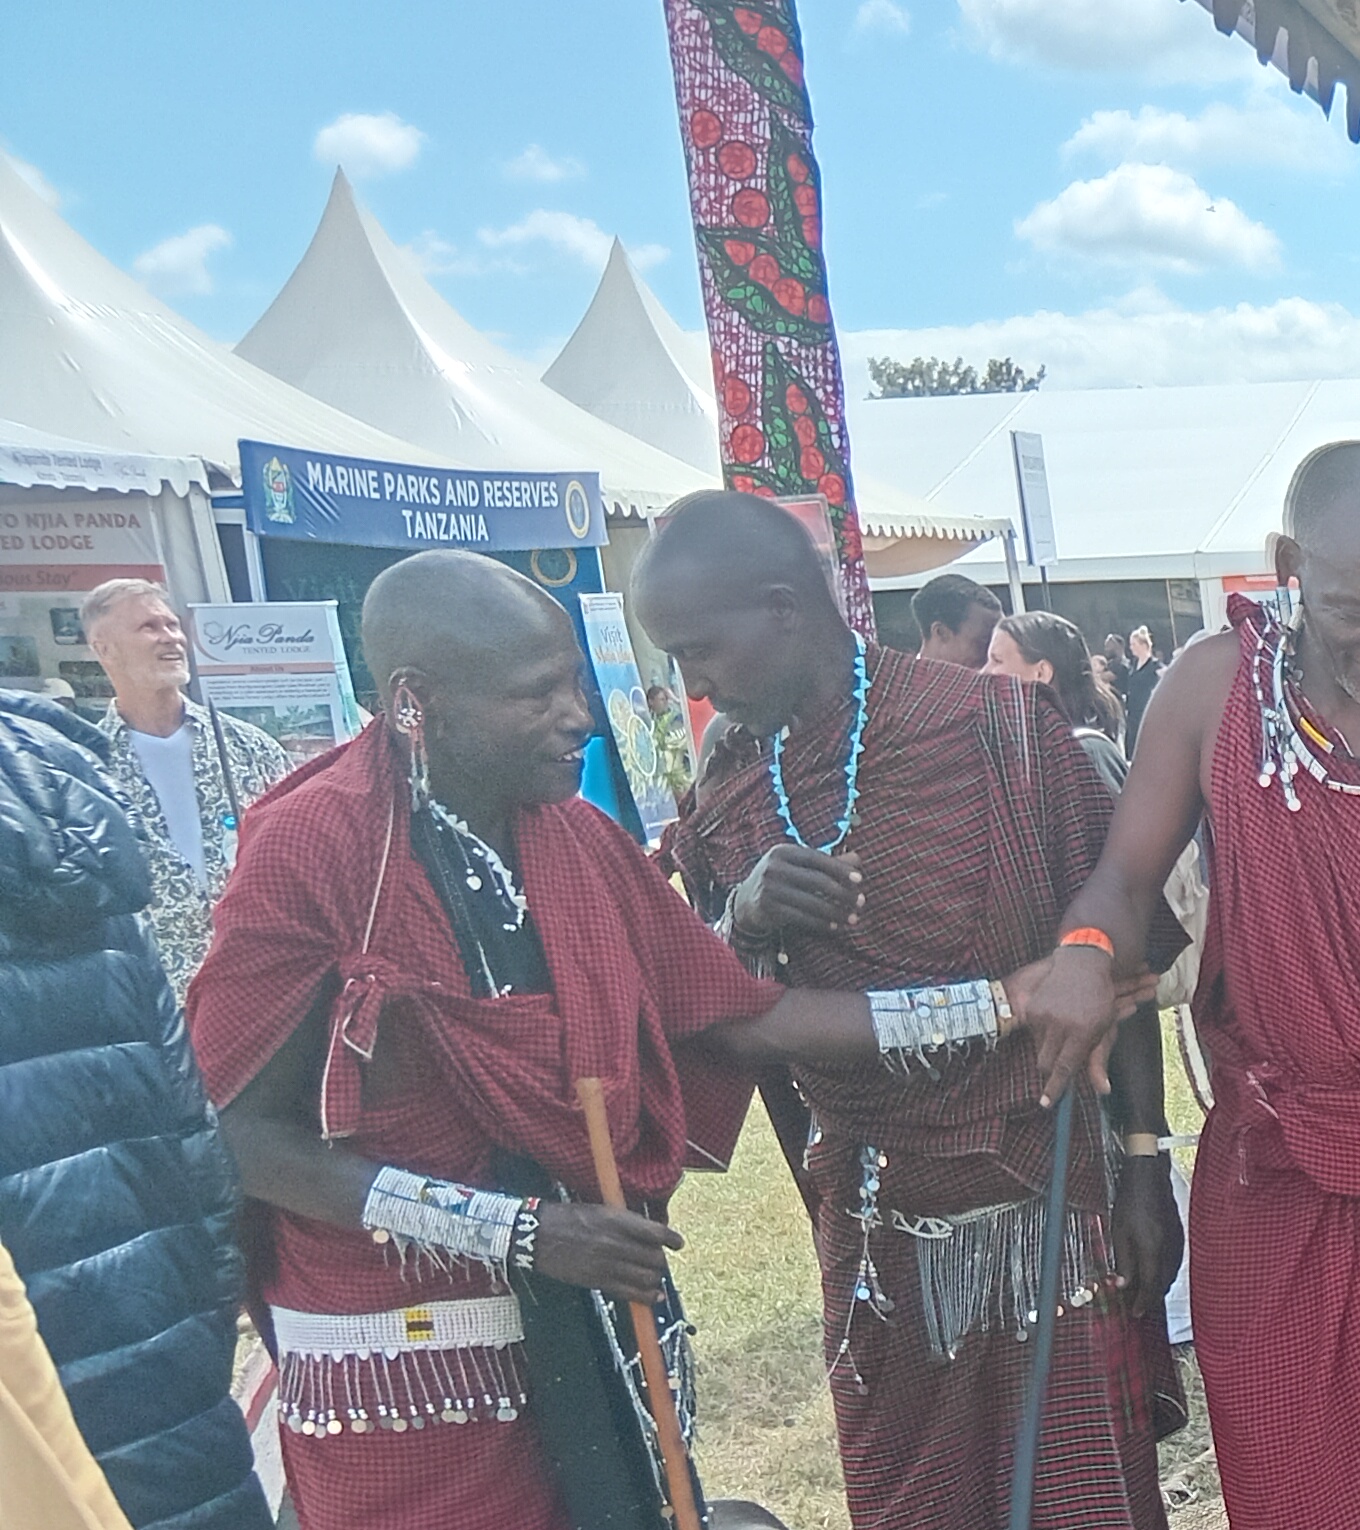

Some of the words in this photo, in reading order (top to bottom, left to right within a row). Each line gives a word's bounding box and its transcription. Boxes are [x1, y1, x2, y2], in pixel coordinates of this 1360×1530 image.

[306, 460, 380, 499] MARINE
[384, 472, 441, 506] PARKS
[446, 478, 480, 507] AND
[484, 480, 560, 508] RESERVES
[26, 513, 68, 531] NJIA
[74, 513, 142, 529] PANDA
[402, 509, 490, 541] TANZANIA
[31, 535, 94, 550] LODGE
[209, 624, 253, 650] Njia
[257, 623, 314, 645] Panda
